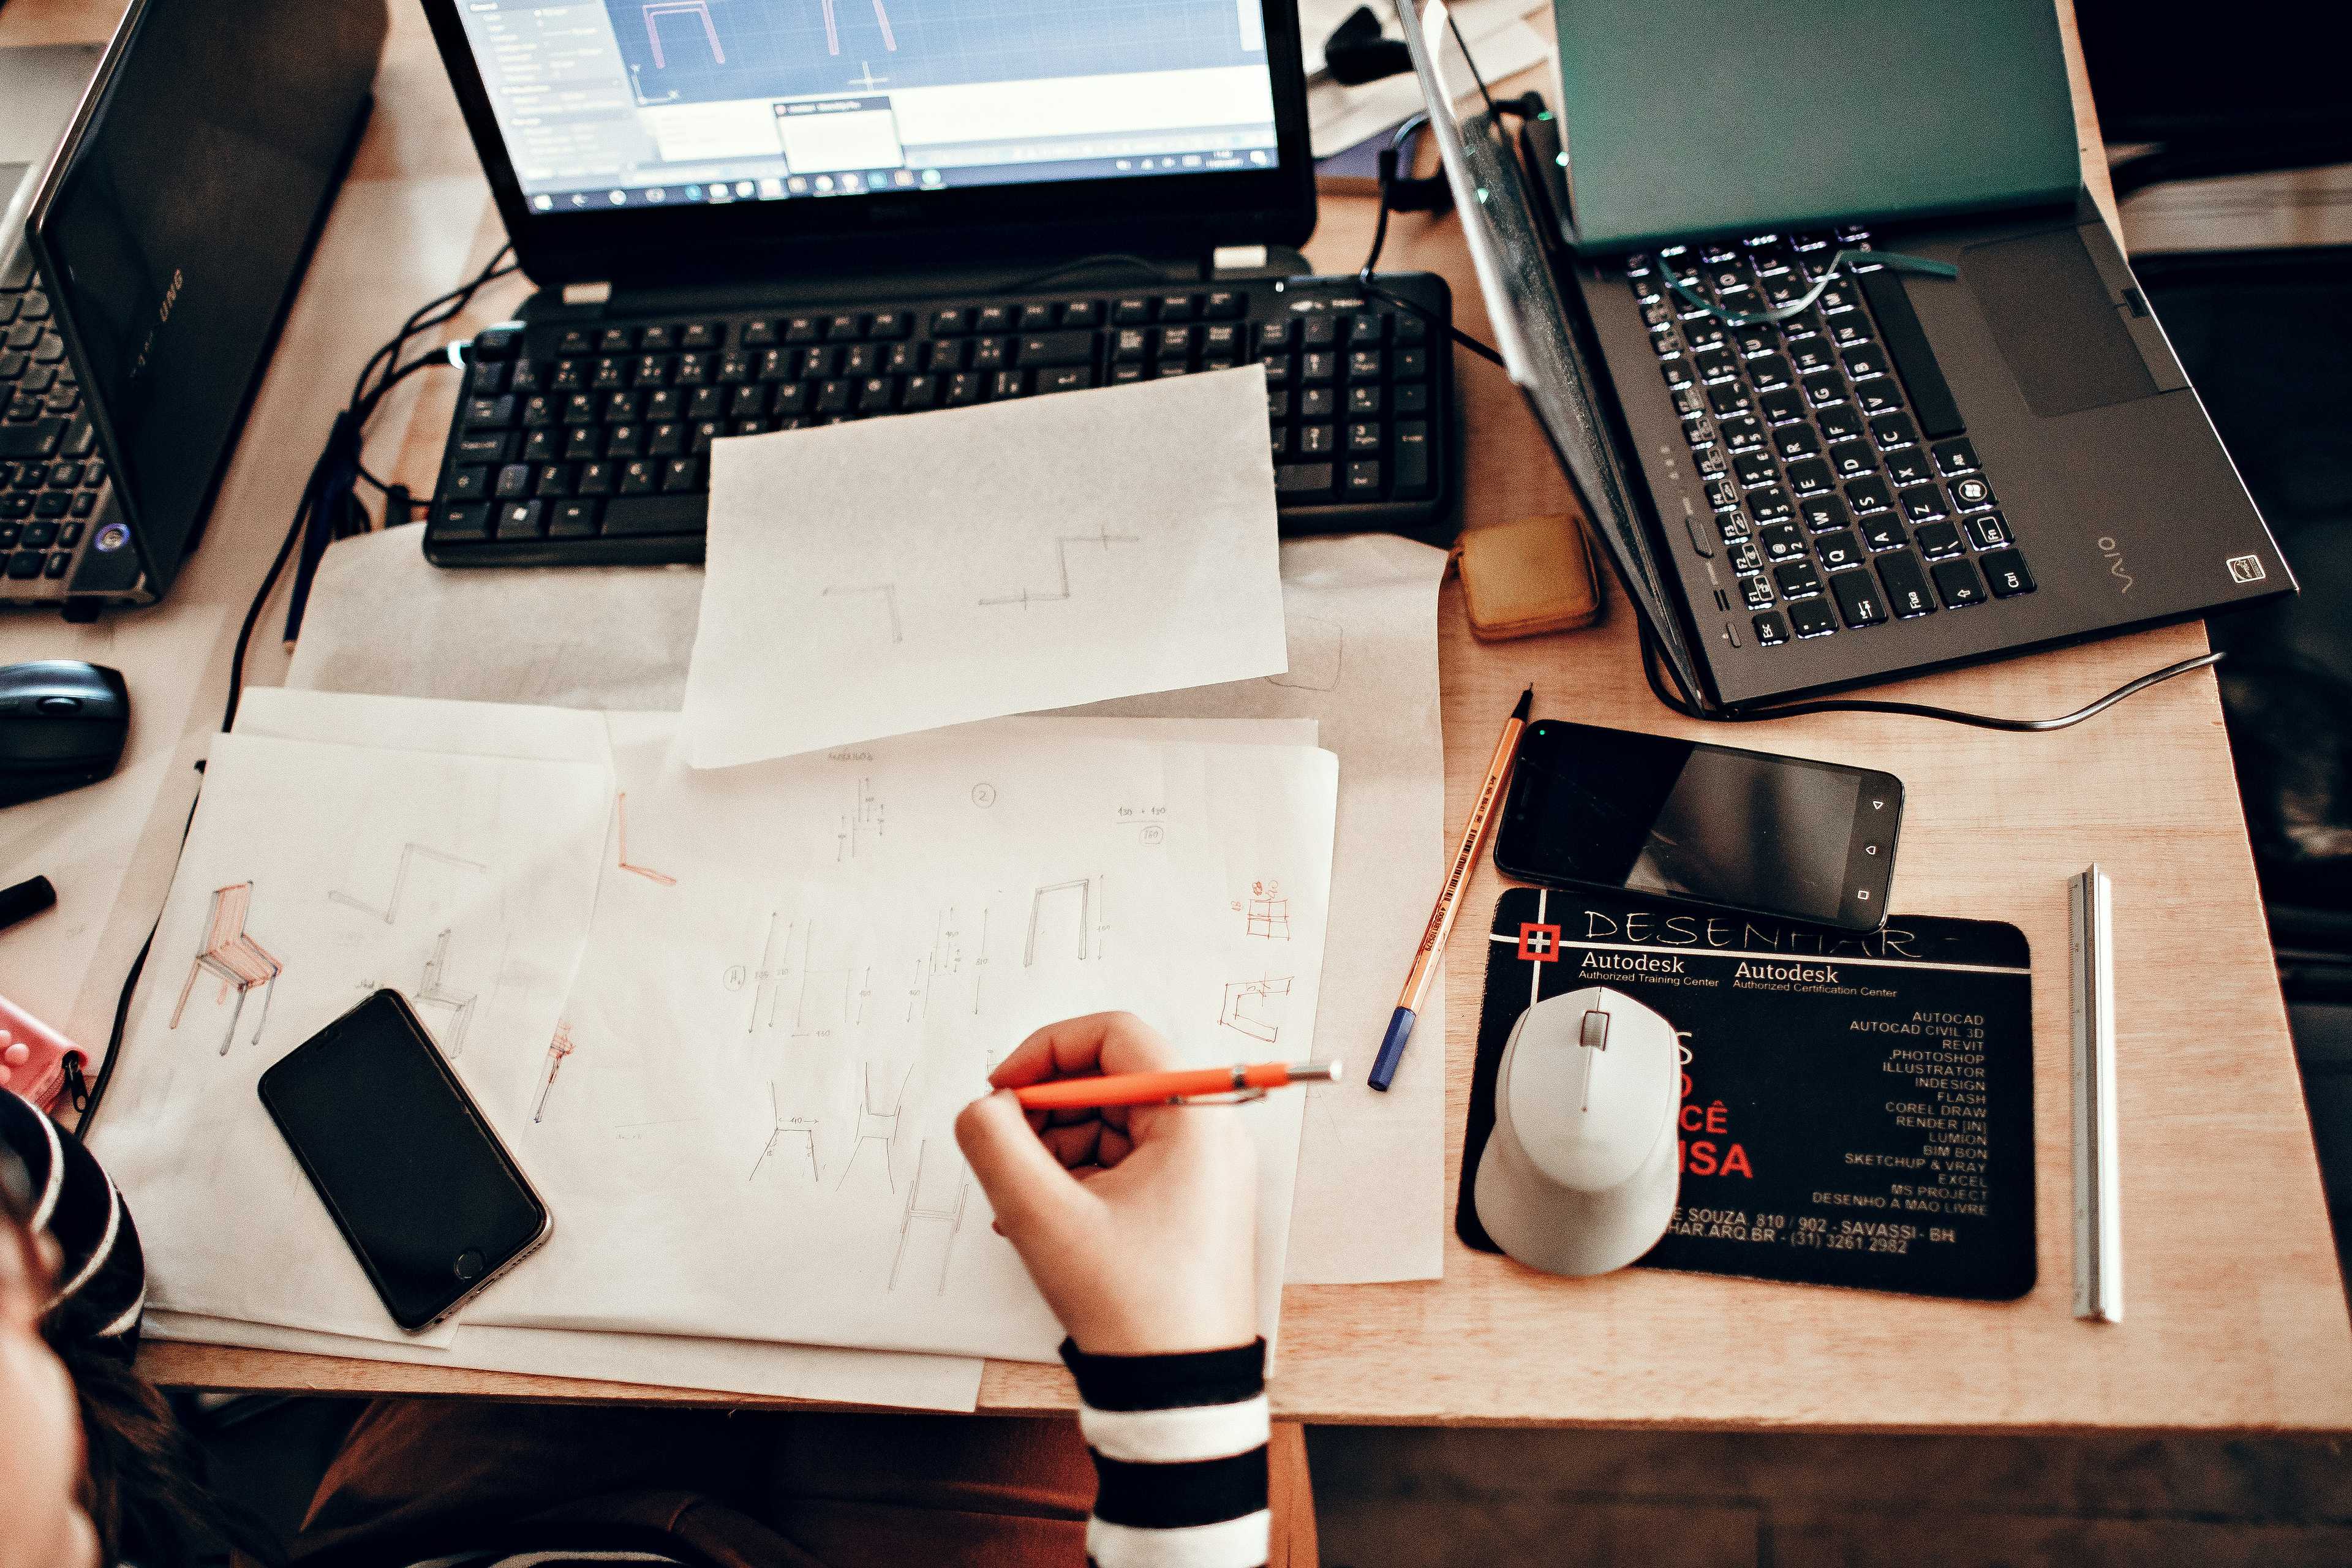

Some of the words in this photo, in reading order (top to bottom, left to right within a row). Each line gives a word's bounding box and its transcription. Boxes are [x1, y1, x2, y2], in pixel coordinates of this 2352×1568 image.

[1800, 353, 1817, 366] H
[1814, 388, 1830, 399] G
[1868, 398, 1883, 407] V
[1772, 409, 1787, 418] T
[1829, 426, 1845, 435] F
[1882, 431, 1898, 442] C
[1786, 442, 1801, 454] R
[1844, 459, 1860, 470] D
[1899, 467, 1915, 478] X
[1800, 478, 1815, 489] E
[1859, 496, 1874, 506] S
[1777, 505, 1789, 513] 3
[1913, 504, 1930, 515] Z
[1813, 512, 1830, 525] W
[1874, 532, 1890, 542] A
[1988, 529, 1999, 541] Fn
[1790, 541, 1803, 550] 2
[1829, 549, 1845, 562] Q
[1736, 557, 1748, 569] F2
[2098, 537, 2133, 594] VAIO
[2004, 572, 2019, 588] Ctrl
[1748, 591, 1760, 603] F1
[1909, 591, 1921, 609] Fixa
[1762, 624, 1774, 638] Esc
[1582, 952, 1684, 973] Autodesk
[1578, 970, 1635, 982] Authorized
[1638, 973, 1680, 987] Training
[1683, 976, 1719, 987] Center
[1735, 962, 1838, 984] Autodesk
[1733, 979, 1790, 992] Authorized
[1794, 982, 1858, 996] Certification
[1860, 987, 1898, 998] Center
[1912, 1012, 1985, 1026] AUTOCAD
[1850, 1020, 1921, 1035] AUTOCAD
[1925, 1025, 1961, 1038] CIVIL
[1967, 1028, 1985, 1039] 3D
[1942, 1039, 1985, 1051] REVIT
[1891, 1049, 1985, 1064] PHOTOSHOP
[1882, 1062, 1985, 1077] ILLUSTRATOR
[1915, 1077, 1986, 1091] INDESIGN
[1937, 1091, 1986, 1104] FLASH
[1885, 1102, 1935, 1115] COREL
[1940, 1105, 1987, 1118] DRAW
[1896, 1115, 1958, 1130] RENDER
[1929, 1132, 1988, 1146] LUMION
[1923, 1145, 1951, 1157] BIM
[1954, 1147, 1988, 1160] BON
[1844, 1152, 1926, 1169] SKETCHUP
[1945, 1160, 1986, 1174] VRAY
[1937, 1173, 1987, 1187] EXCEL
[1891, 1183, 1913, 1196] MS
[1917, 1185, 1988, 1201] PROJECT
[1812, 1191, 1887, 1208] DESENHO
[1890, 1197, 1901, 1209] A
[1943, 1201, 1988, 1216] LIVRE
[1755, 1213, 1785, 1229] 810
[1798, 1215, 1827, 1233] 902
[1841, 1220, 1917, 1241] SAVASSI
[1929, 1227, 1956, 1243] BH
[1790, 1231, 1821, 1250] (31)
